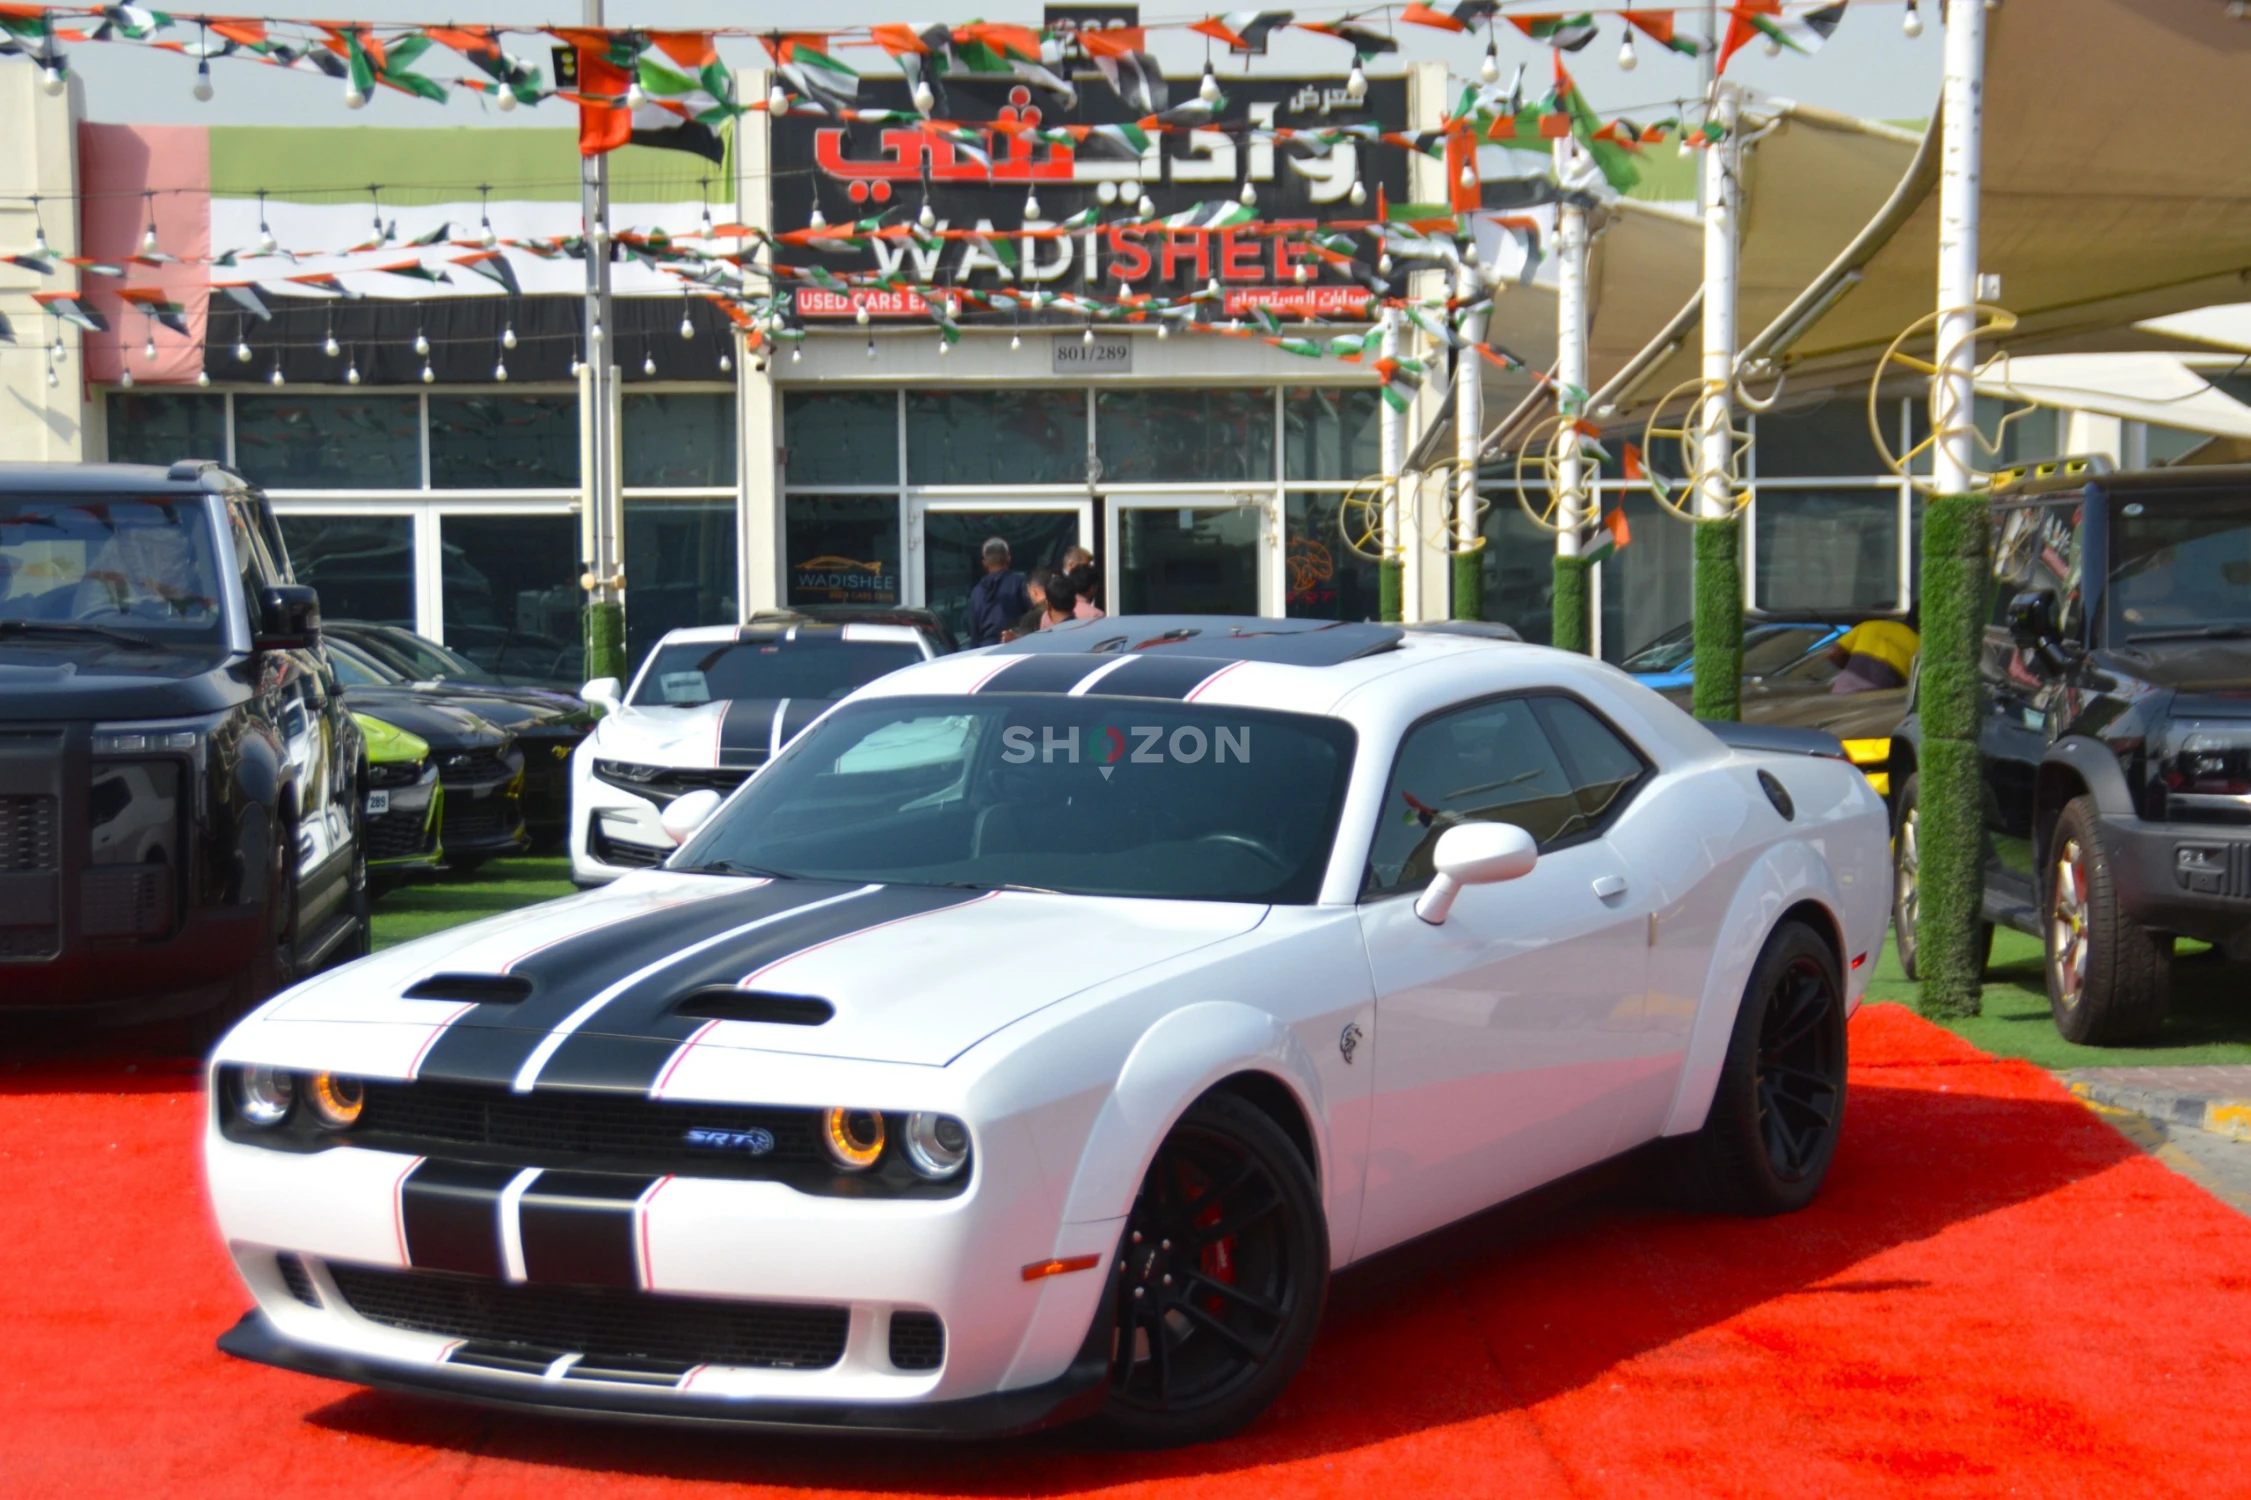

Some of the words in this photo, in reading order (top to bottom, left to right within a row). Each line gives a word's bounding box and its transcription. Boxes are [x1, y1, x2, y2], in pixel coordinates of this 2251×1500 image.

[800, 292, 848, 310] USED
[853, 292, 903, 310] CARS
[1057, 344, 1127, 362] 801/289
[798, 574, 894, 590] WADISHEE
[685, 1130, 752, 1146] SRT
